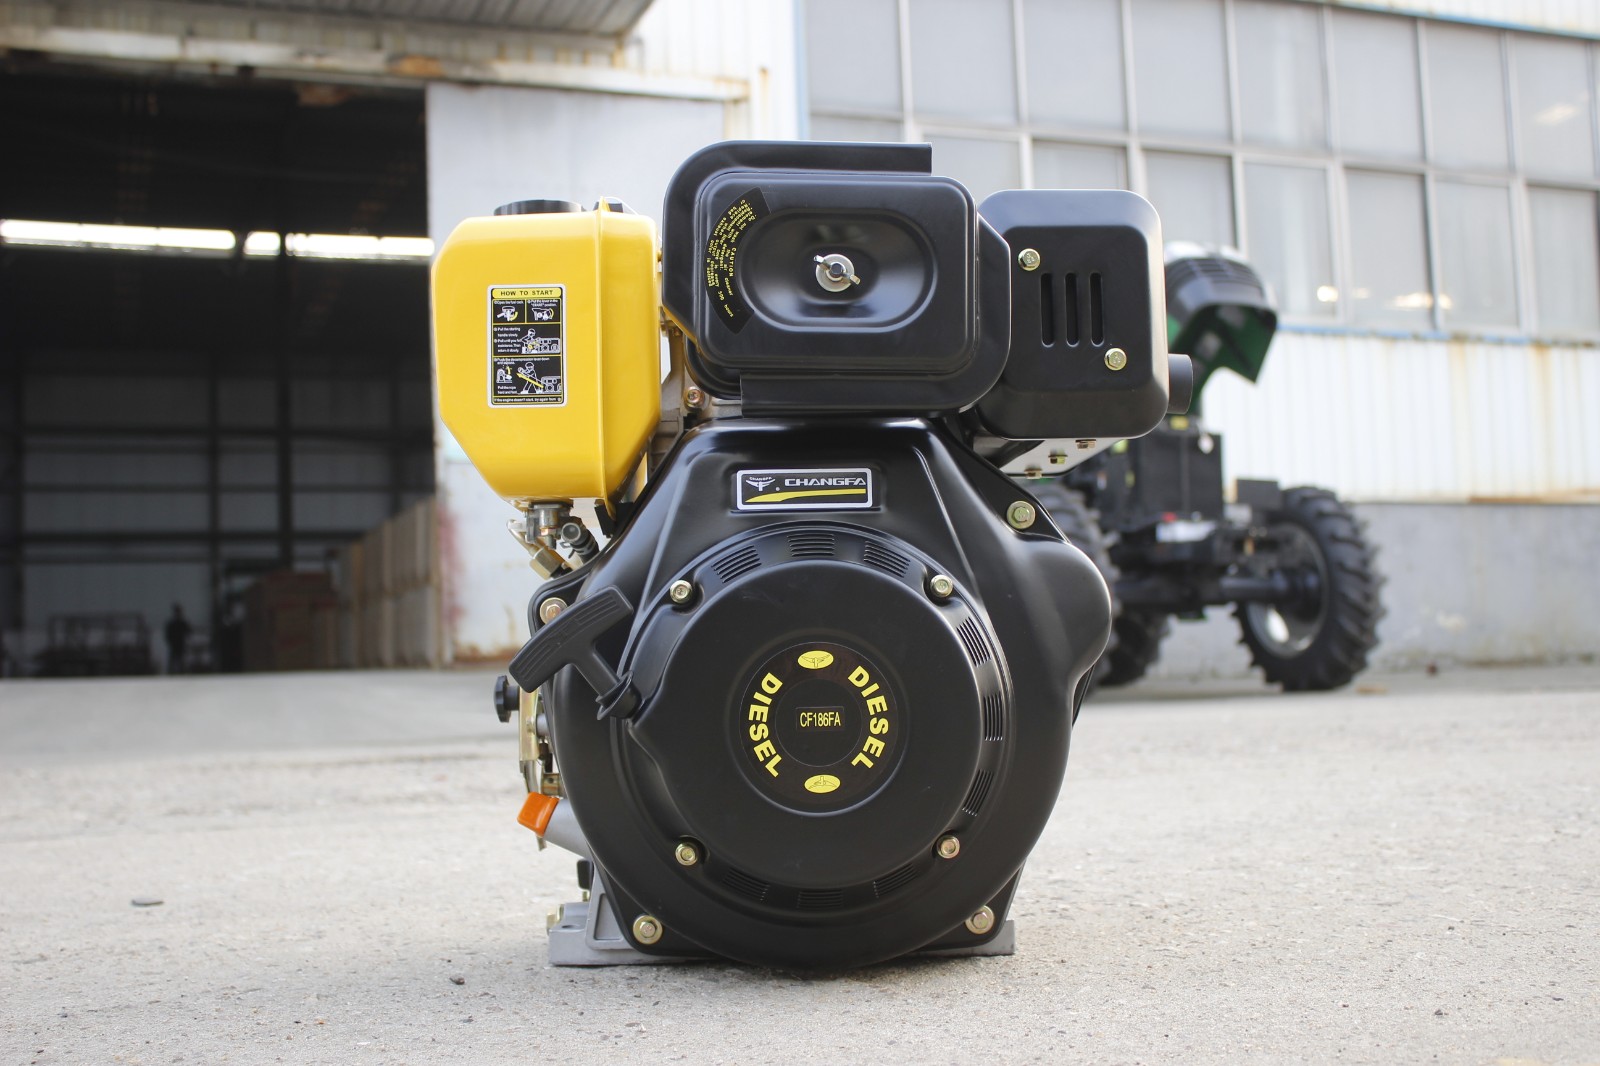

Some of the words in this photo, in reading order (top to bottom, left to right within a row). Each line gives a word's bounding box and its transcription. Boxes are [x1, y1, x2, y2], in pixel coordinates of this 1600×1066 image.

[785, 477, 866, 486] CHANGFA
[749, 672, 783, 778] DIESEL
[799, 712, 841, 727] CF186FA
[848, 665, 889, 769] DIESEL
